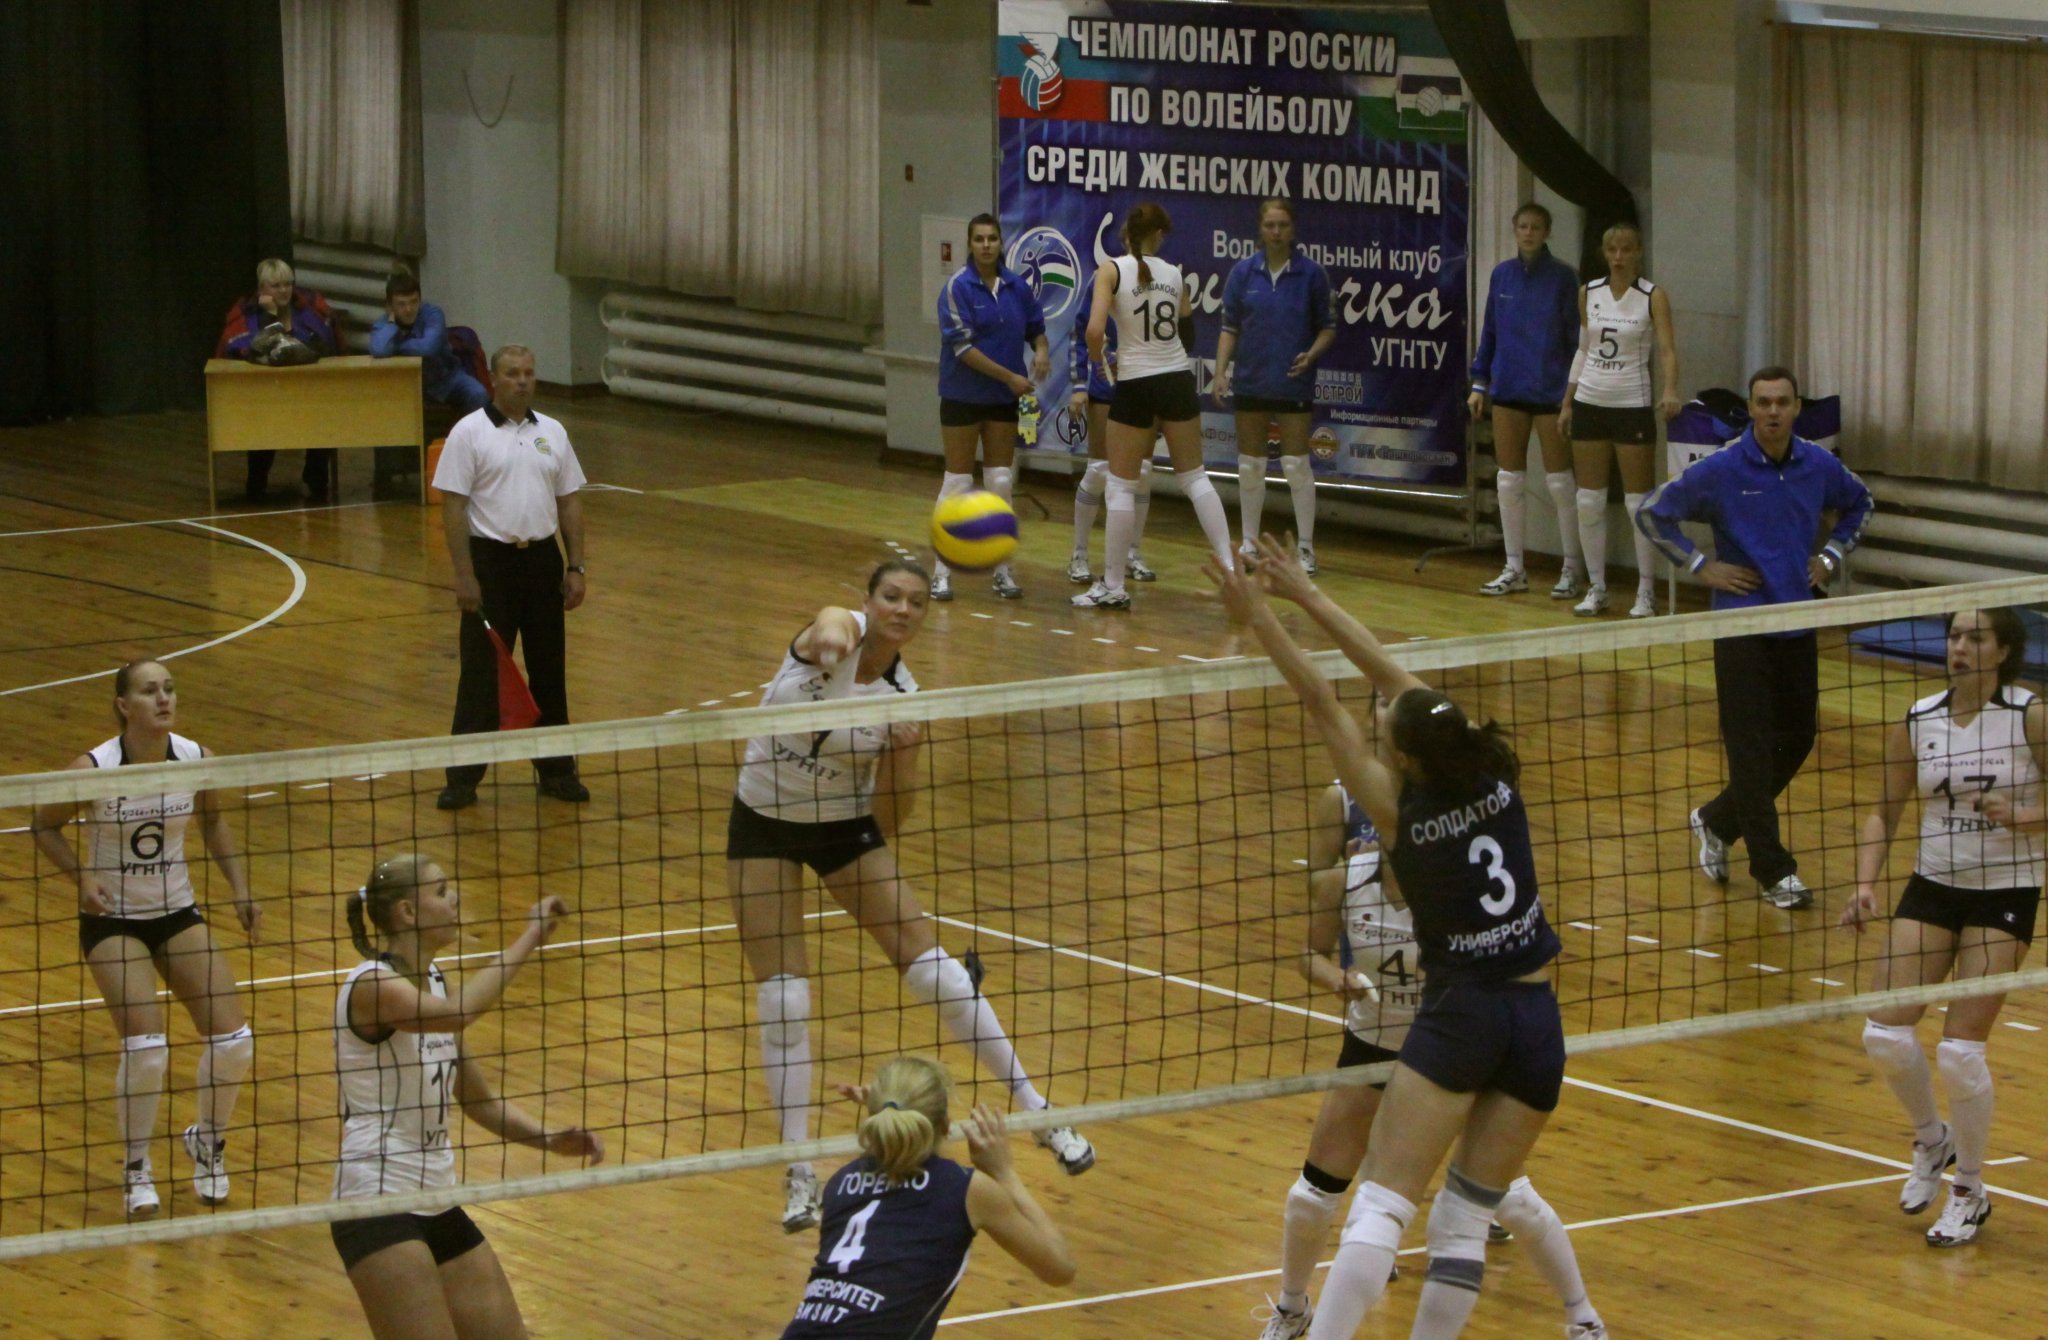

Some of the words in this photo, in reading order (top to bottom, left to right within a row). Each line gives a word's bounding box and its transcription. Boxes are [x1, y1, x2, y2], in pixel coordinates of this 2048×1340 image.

[1069, 20, 1257, 66] ЧЕМПИОНАТ
[1267, 30, 1396, 74] РОССИИ
[1110, 86, 1149, 125] ПО
[1162, 86, 1352, 137] ВОЛЕЙБОЛУ
[1027, 145, 1128, 192] СРЕДИ
[1139, 151, 1291, 199] ЖЕНСКИХ
[1302, 161, 1441, 215] КОМАНД
[1389, 245, 1442, 280] клуб
[1133, 299, 1176, 342] 18
[1371, 336, 1448, 370] УГНТУ
[1599, 327, 1619, 359] 5
[1933, 774, 1997, 812] 17
[131, 821, 164, 859] 6
[1468, 835, 1516, 917] 3
[1377, 949, 1415, 987] 4
[827, 1199, 882, 1275] 4
